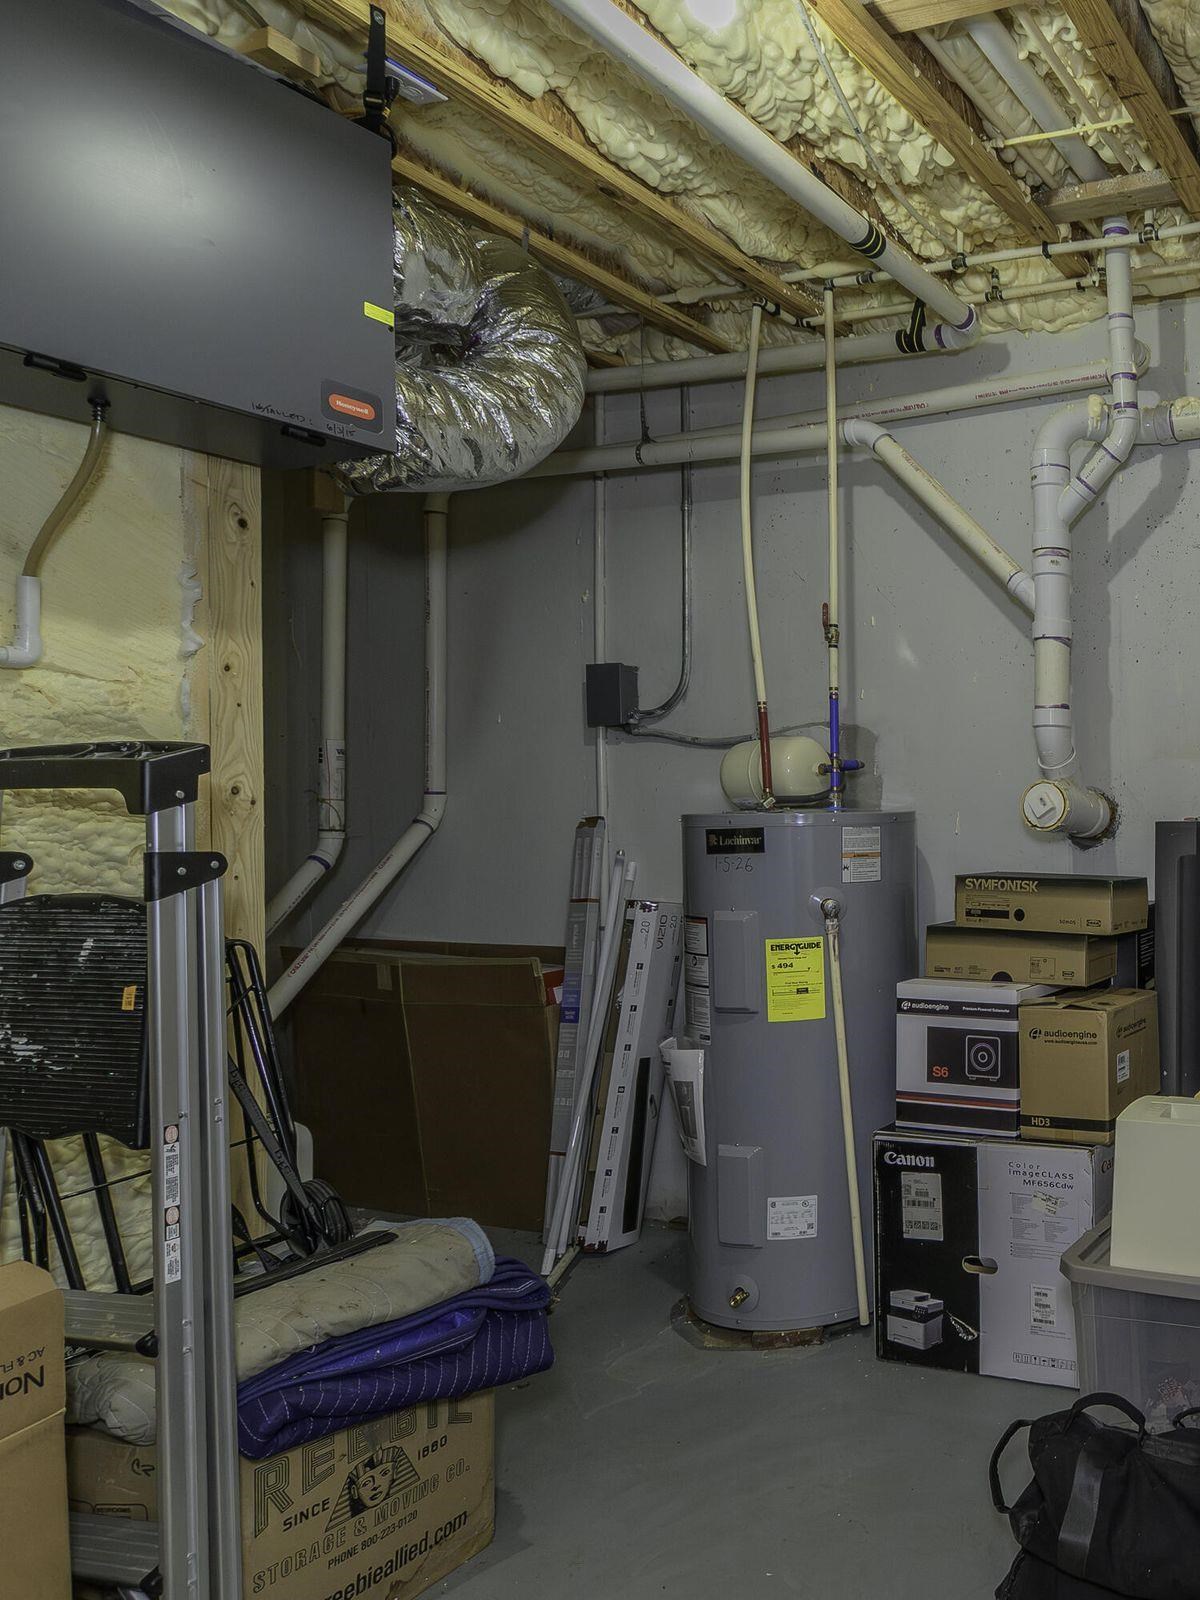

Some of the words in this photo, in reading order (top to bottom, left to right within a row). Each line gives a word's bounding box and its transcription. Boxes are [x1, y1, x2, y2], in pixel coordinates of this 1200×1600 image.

[336, 399, 369, 415] Honeywell
[719, 834, 762, 846] Lochinvar
[965, 878, 1039, 893] SYMFONISK
[656, 914, 668, 949] VIZIO
[770, 942, 822, 955] ENERGYGUIDE
[911, 1002, 949, 1011] audioengine
[1044, 1029, 1098, 1040] audioengine
[932, 1065, 949, 1078] S6
[1031, 1117, 1051, 1127] HD3
[884, 1151, 935, 1168] Canon
[1008, 1161, 1041, 1170] Color
[1008, 1169, 1074, 1181] imageCLASS
[1023, 1179, 1074, 1190] MF656Cdw
[28, 1346, 46, 1362] AC
[16, 1355, 25, 1367] &
[282, 1498, 330, 1532] SINCE
[417, 1435, 448, 1461] 1880
[253, 1525, 346, 1594] STORAGE
[353, 1516, 368, 1537] &
[374, 1473, 440, 1527] MOVING
[445, 1457, 471, 1483] CO.
[327, 1542, 359, 1570] PHONE
